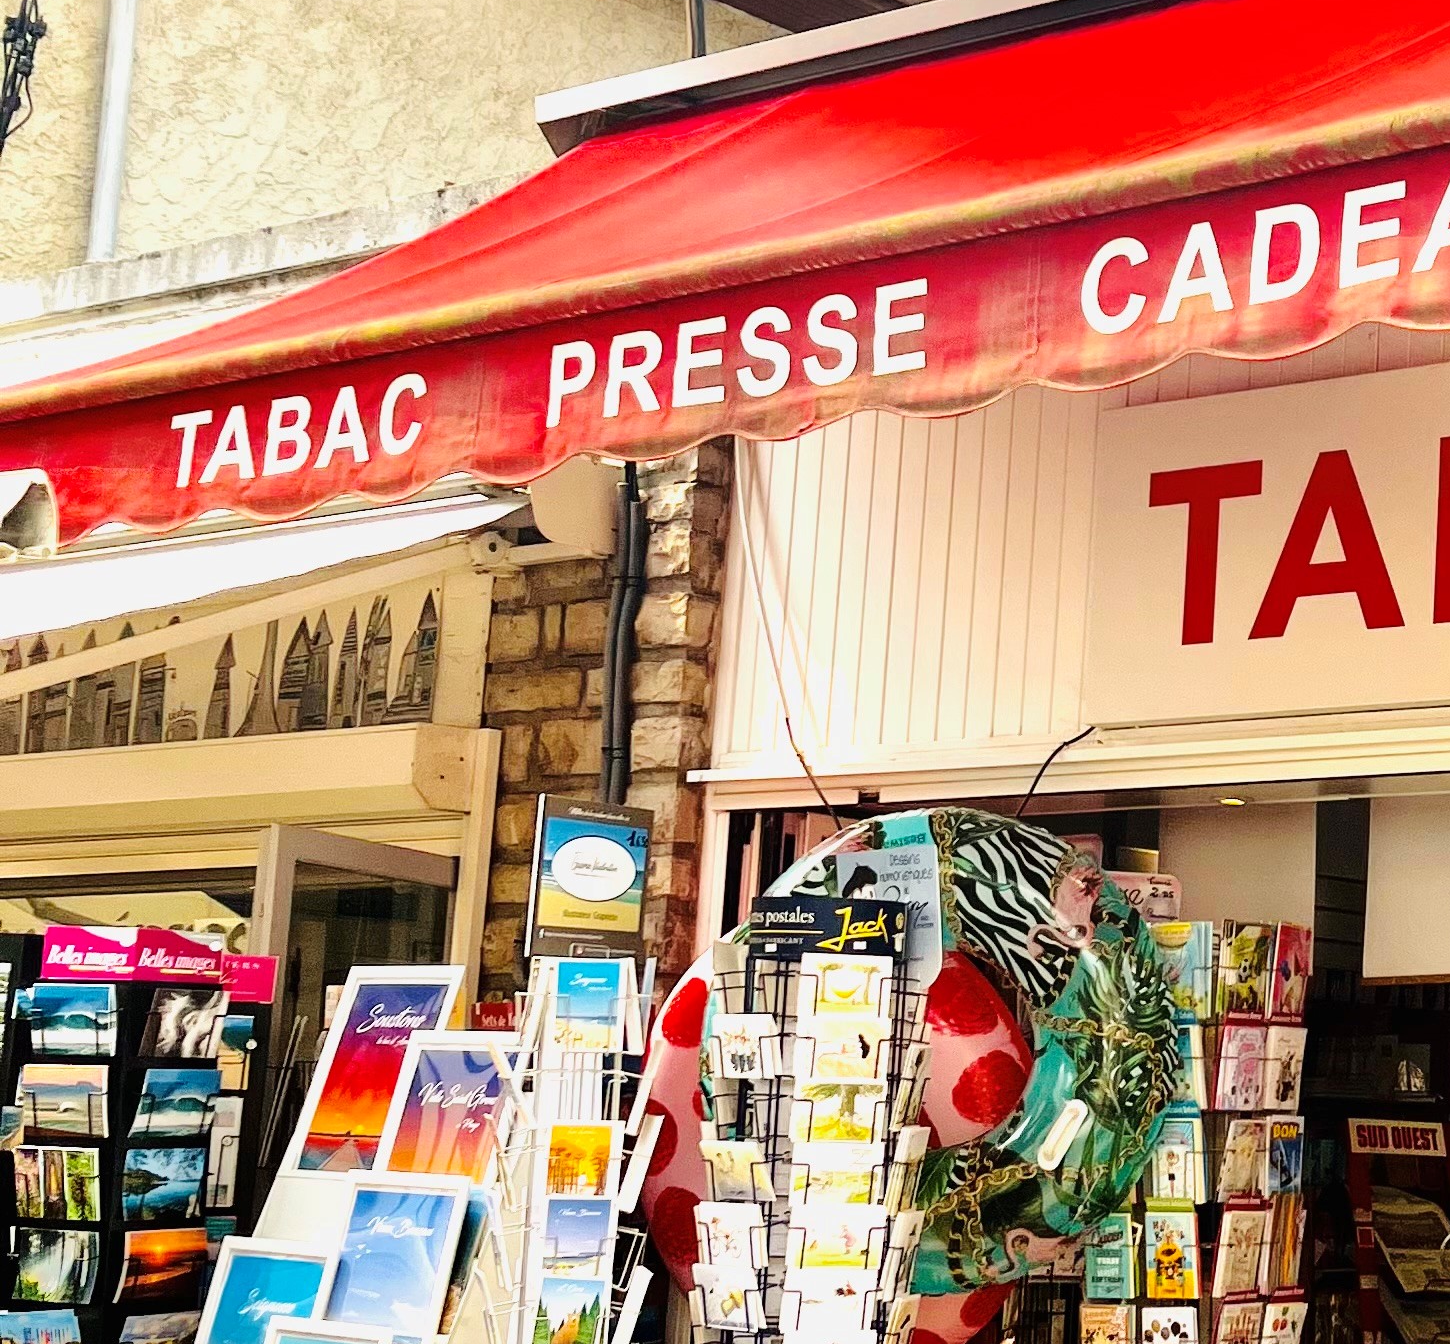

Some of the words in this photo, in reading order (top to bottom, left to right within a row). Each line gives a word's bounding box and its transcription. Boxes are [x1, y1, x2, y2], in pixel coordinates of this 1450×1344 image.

[170, 373, 429, 489] TABAC
[546, 277, 931, 429] PRESSE
[765, 905, 816, 927] postales
[815, 906, 889, 953] Jack
[46, 944, 84, 966] Belles
[137, 947, 176, 969] Belles
[174, 951, 217, 973] images
[1355, 1124, 1390, 1150] SUD
[1391, 1126, 1439, 1151] OUEST
